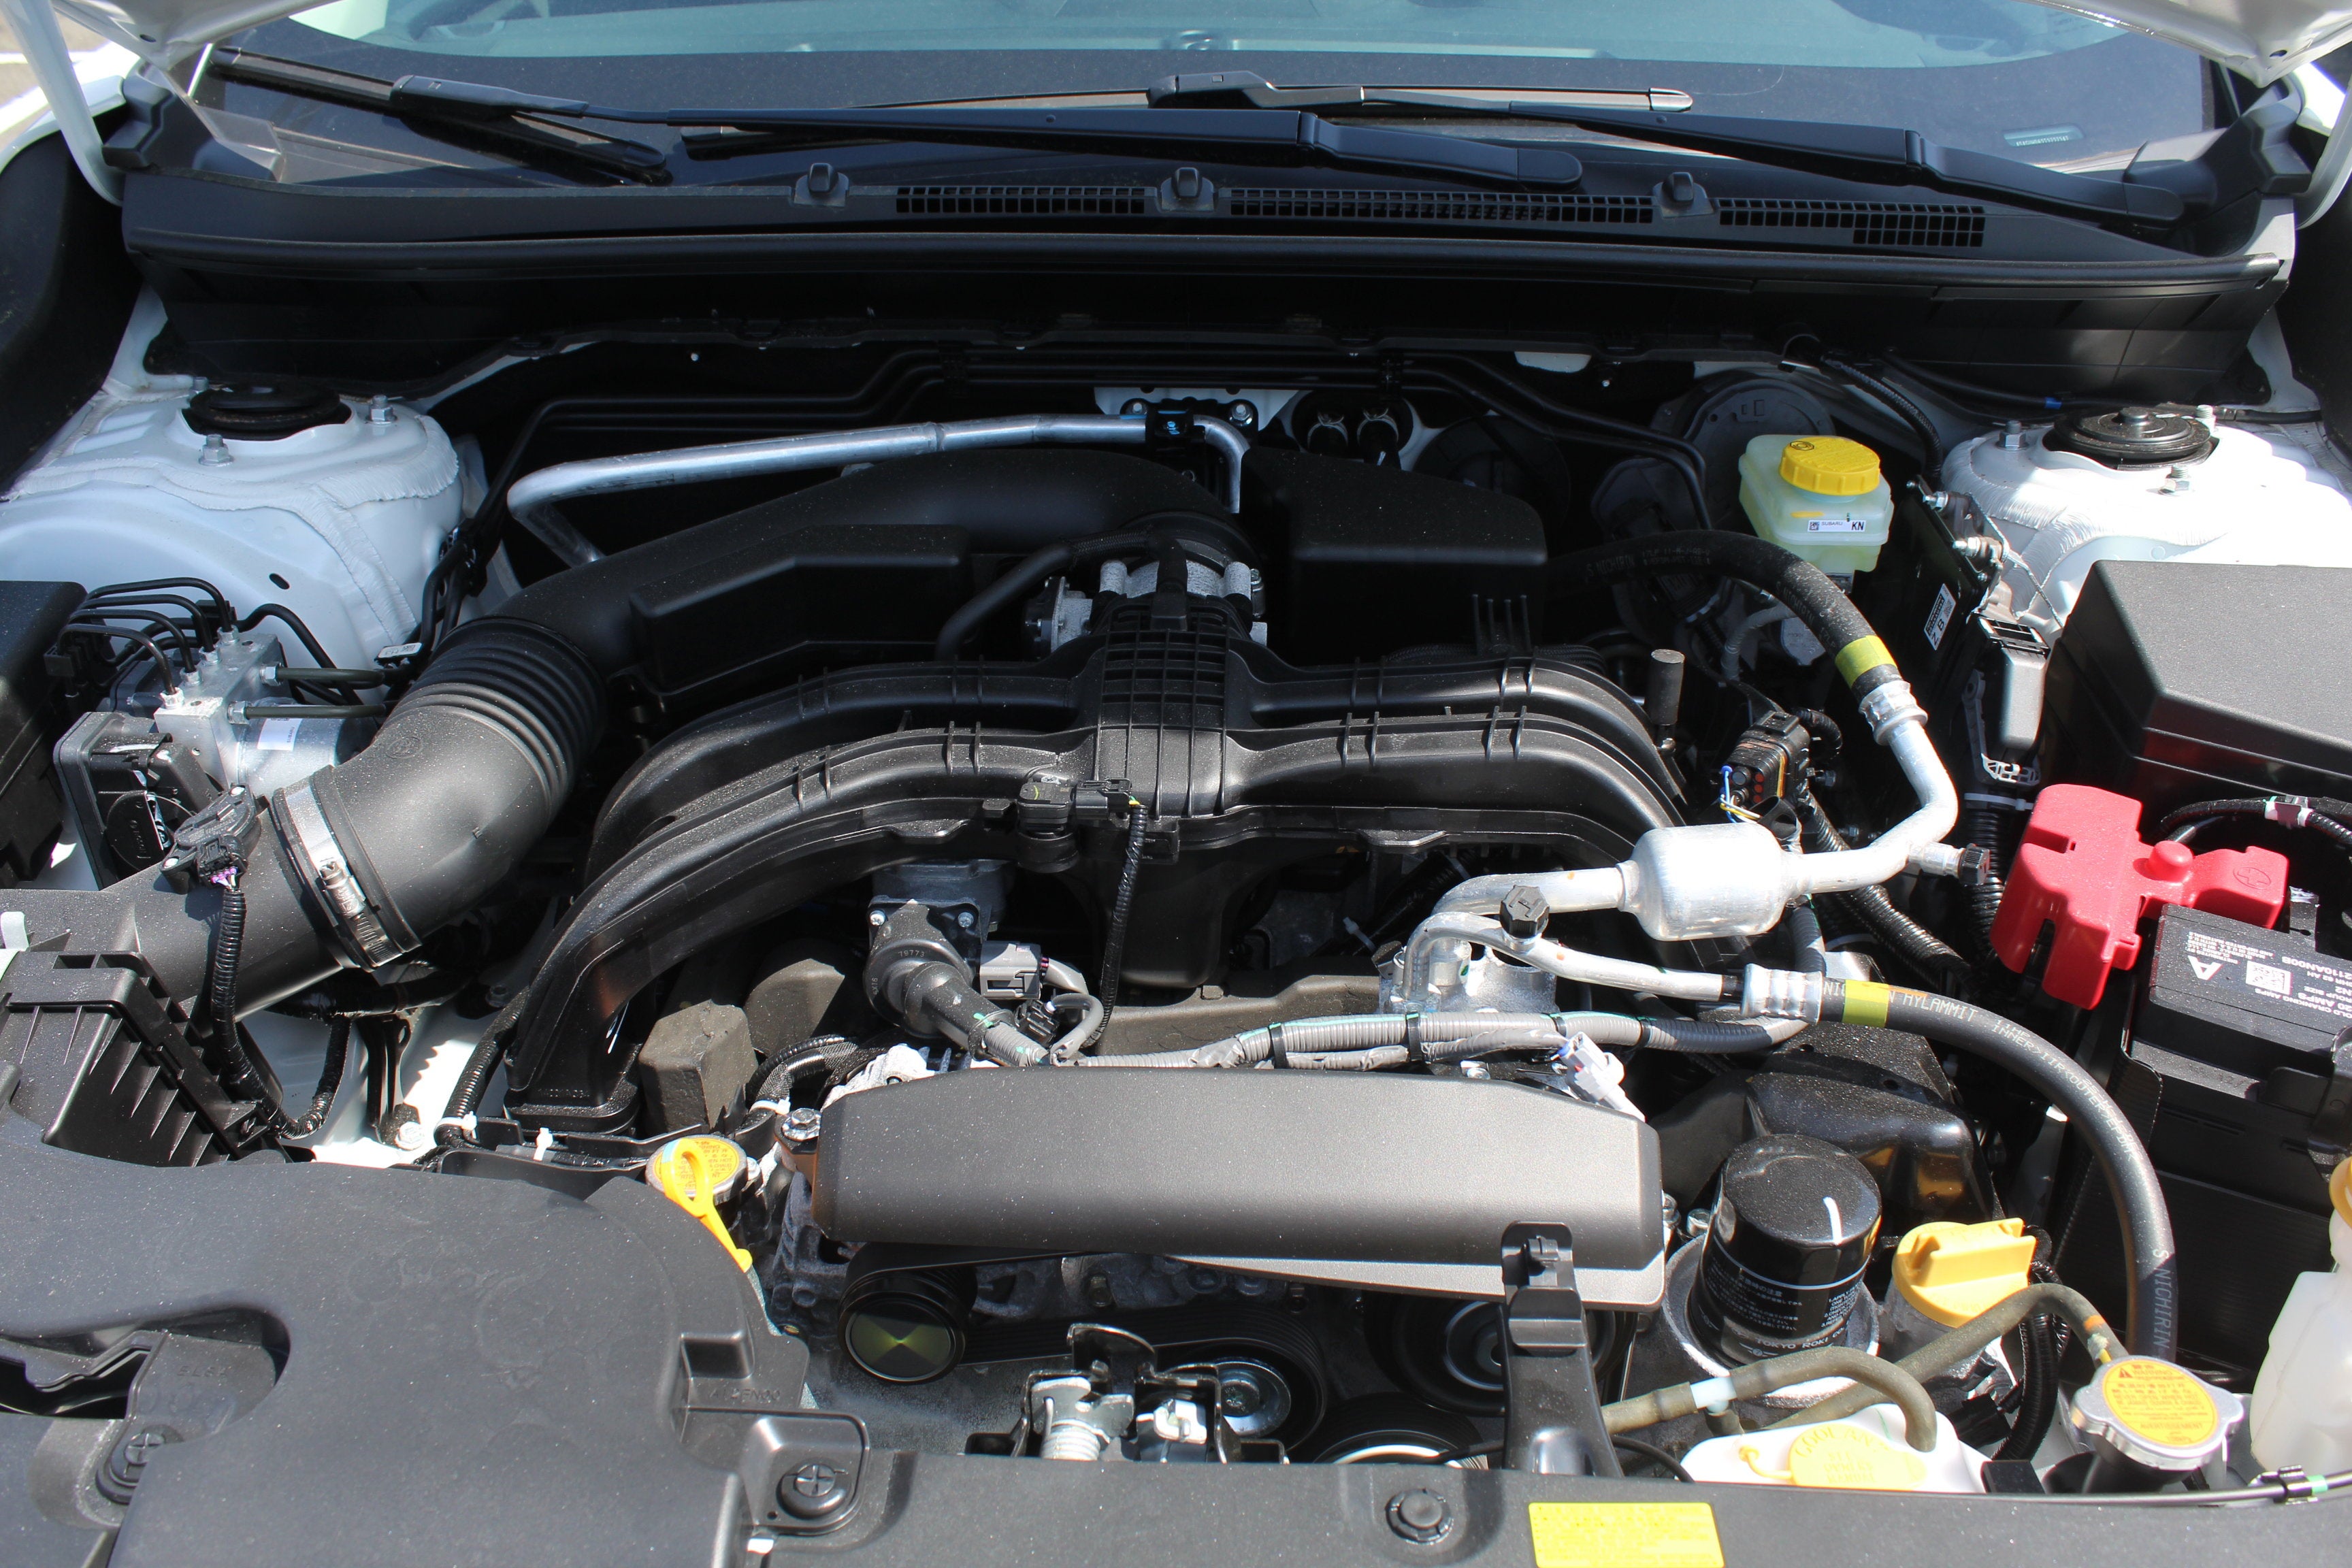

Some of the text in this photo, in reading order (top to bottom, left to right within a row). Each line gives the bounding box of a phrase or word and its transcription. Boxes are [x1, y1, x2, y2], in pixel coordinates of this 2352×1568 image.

[1851, 521, 1865, 532] KN
[898, 949, 926, 958] 79773
[2188, 956, 2224, 981] A
[2306, 970, 2321, 979] AH
[2255, 987, 2281, 999] AMPS
[2304, 985, 2323, 995] SIZE
[2335, 985, 2352, 996] N2
[1824, 981, 1979, 1022] NICN HYLAMMIT
[2282, 995, 2331, 1013] CRANKING
[2298, 992, 2335, 1007] AMPS
[2153, 1249, 2173, 1350] S NICHIRIN
[1755, 1337, 1797, 1349] TOKYO
[1802, 1337, 1829, 1348] ROKI
